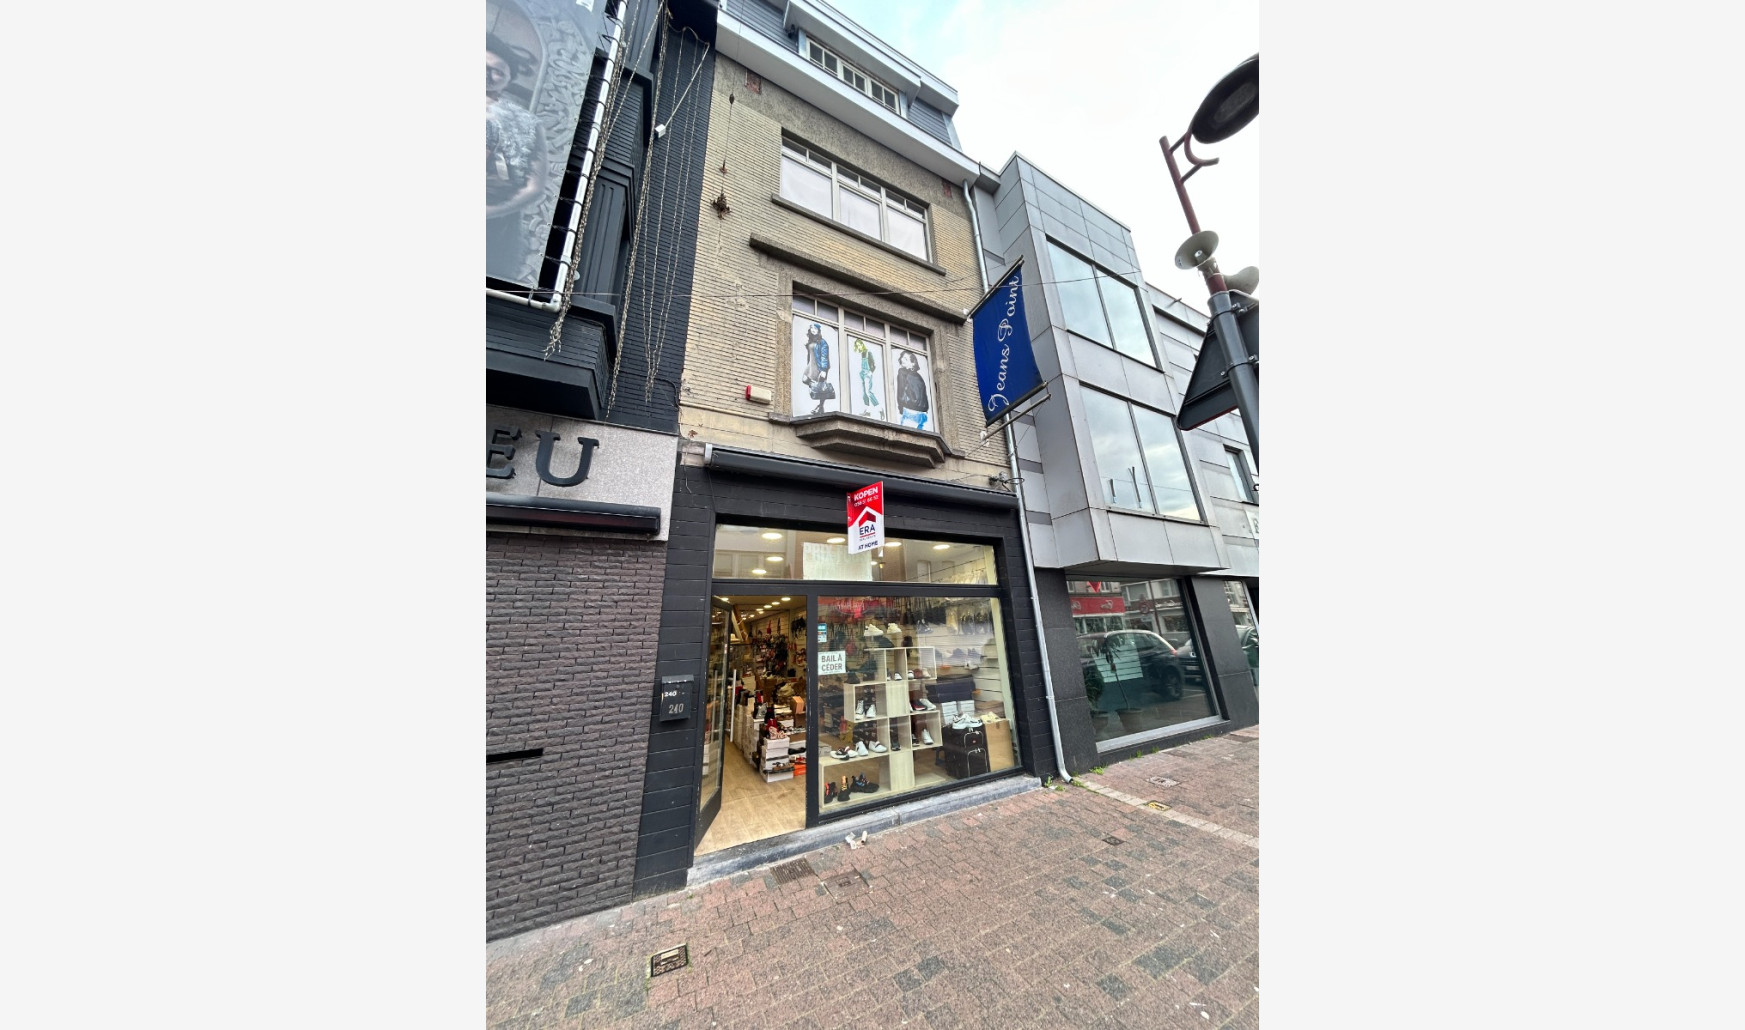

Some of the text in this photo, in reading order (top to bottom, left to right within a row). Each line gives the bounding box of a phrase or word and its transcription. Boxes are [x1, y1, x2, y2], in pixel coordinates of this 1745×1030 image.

[988, 275, 1020, 412] Jeans Point
[854, 486, 878, 501] KOPEN
[859, 524, 875, 535] ERA
[864, 540, 878, 548] HOME
[821, 655, 836, 663] BAIL
[821, 663, 842, 671] CÉDER
[668, 703, 684, 714] 240
